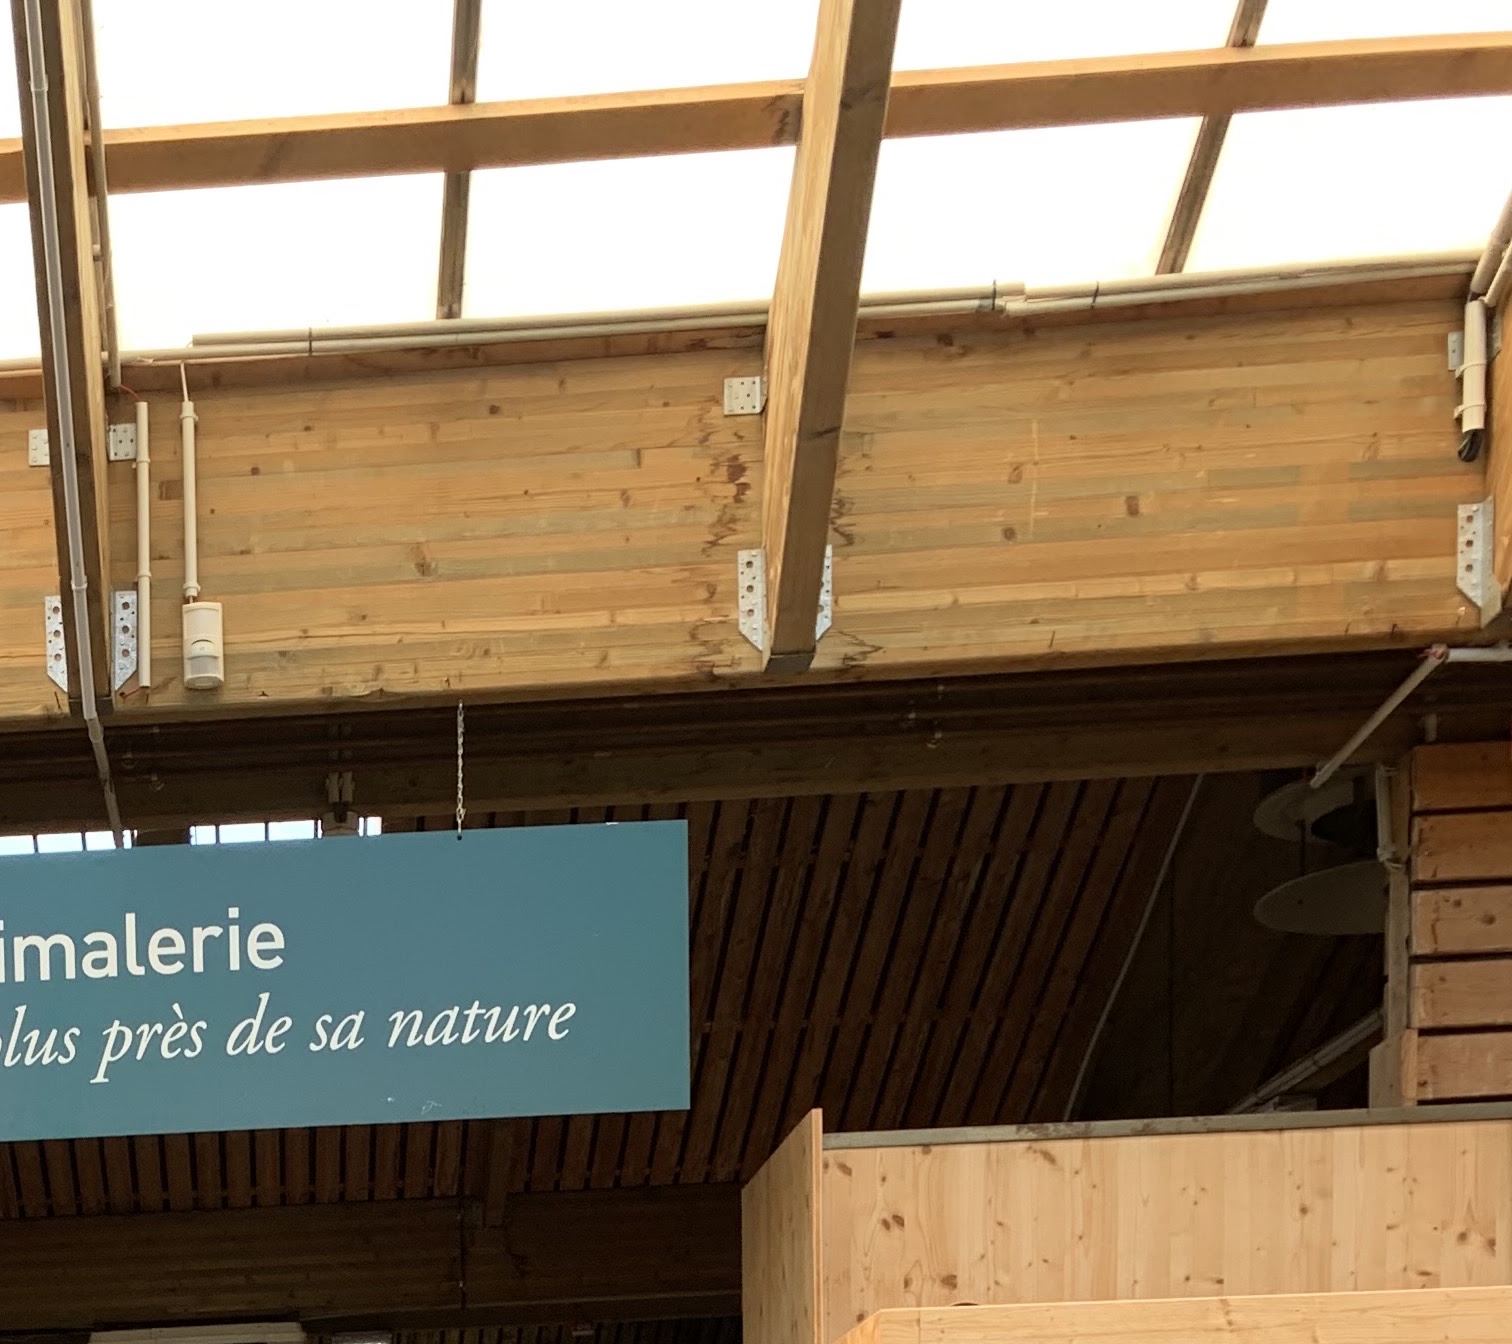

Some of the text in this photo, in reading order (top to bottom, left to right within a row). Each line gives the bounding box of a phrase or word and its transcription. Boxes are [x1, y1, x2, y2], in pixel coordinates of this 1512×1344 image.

[90, 1003, 207, 1083] près
[227, 992, 292, 1055] de
[310, 1011, 364, 1051] sa
[389, 1001, 576, 1047] nature
